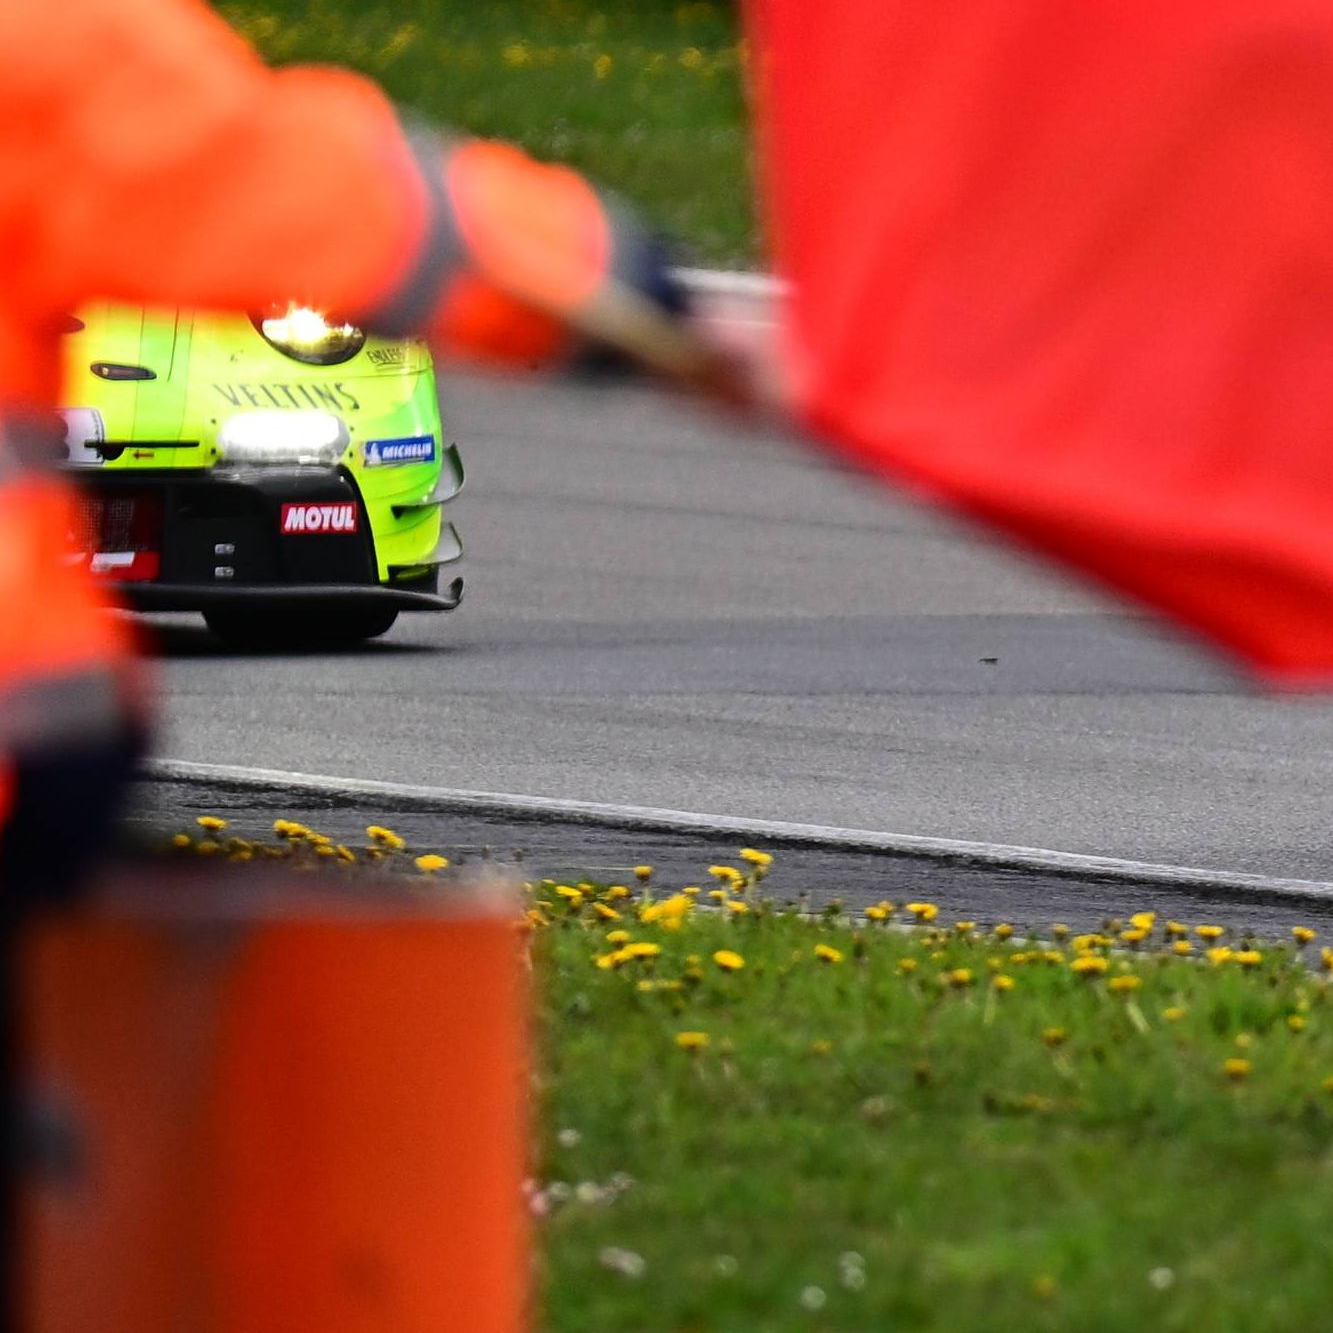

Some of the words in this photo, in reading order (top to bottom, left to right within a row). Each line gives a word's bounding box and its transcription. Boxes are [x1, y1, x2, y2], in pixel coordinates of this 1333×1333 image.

[213, 382, 360, 411] VELTINS
[381, 442, 433, 458] MICHELIN
[284, 505, 355, 532] MOTUL
